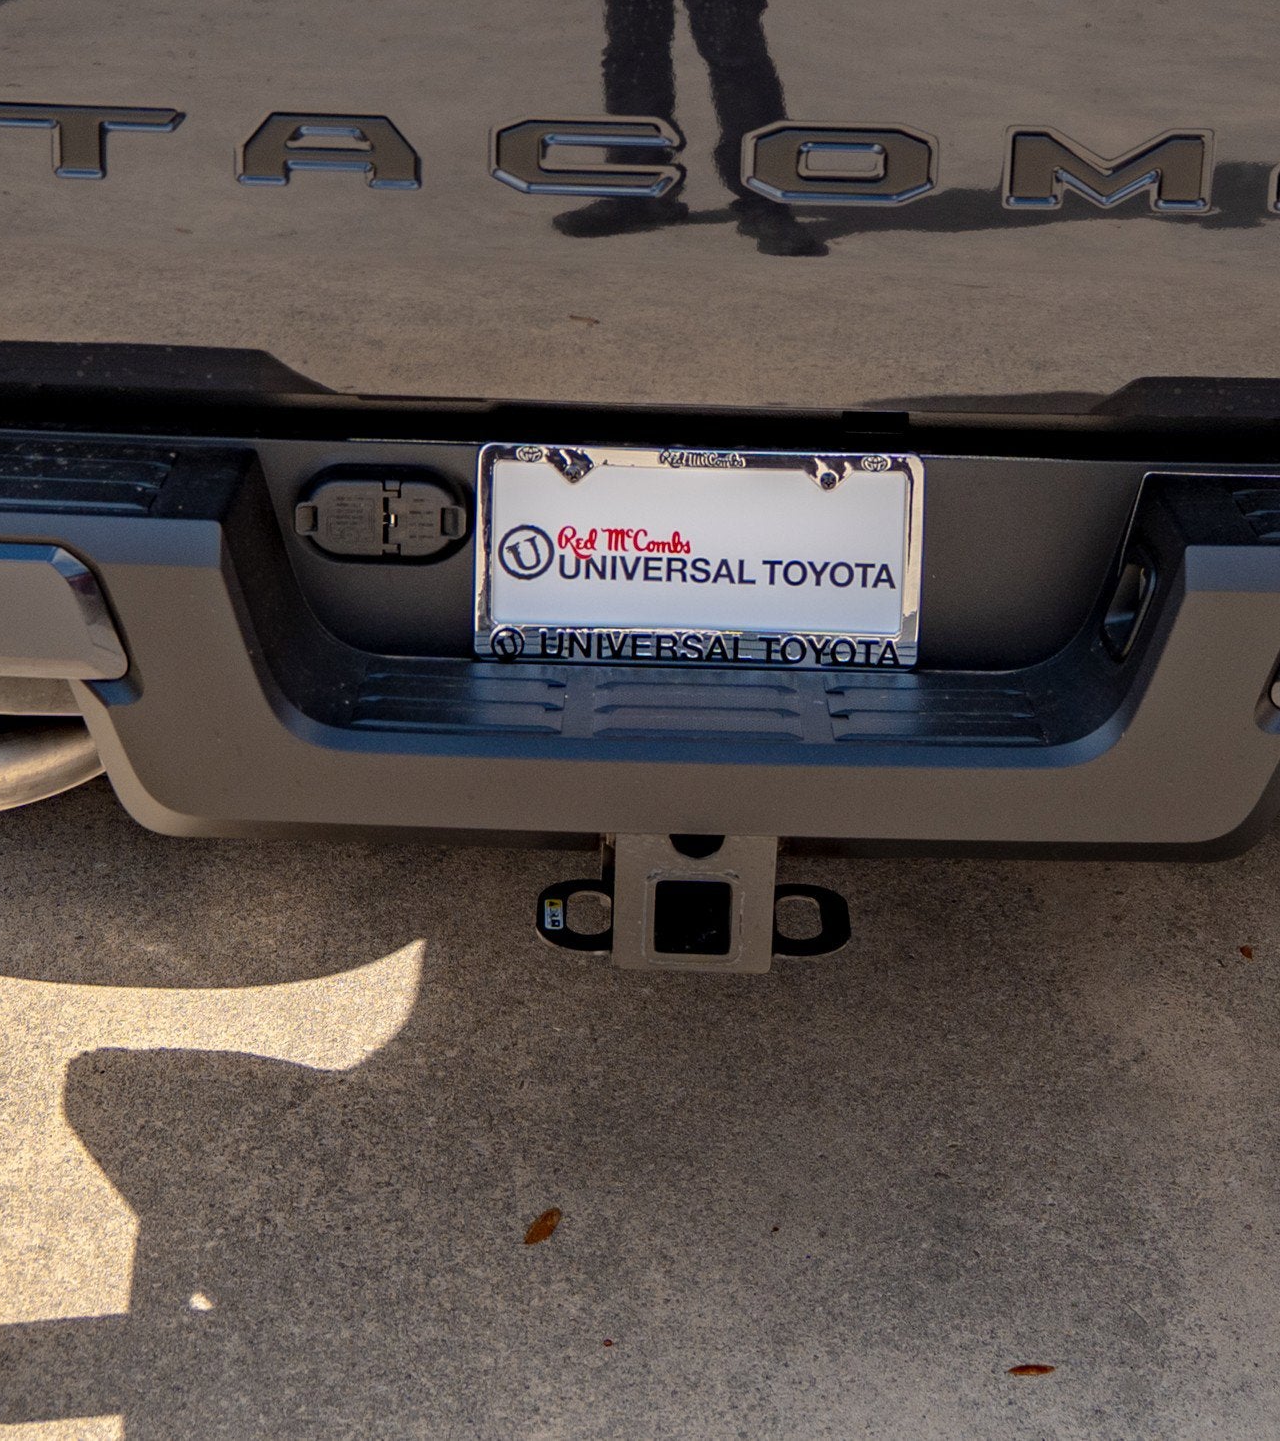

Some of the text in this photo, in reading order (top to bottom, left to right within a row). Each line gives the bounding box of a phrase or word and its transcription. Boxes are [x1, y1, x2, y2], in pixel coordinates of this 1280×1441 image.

[557, 525, 692, 559] Red McCombs
[558, 554, 897, 590] UNIVERSAL TOYOTA
[539, 628, 902, 667] UNIVERSAL TOYOTA
